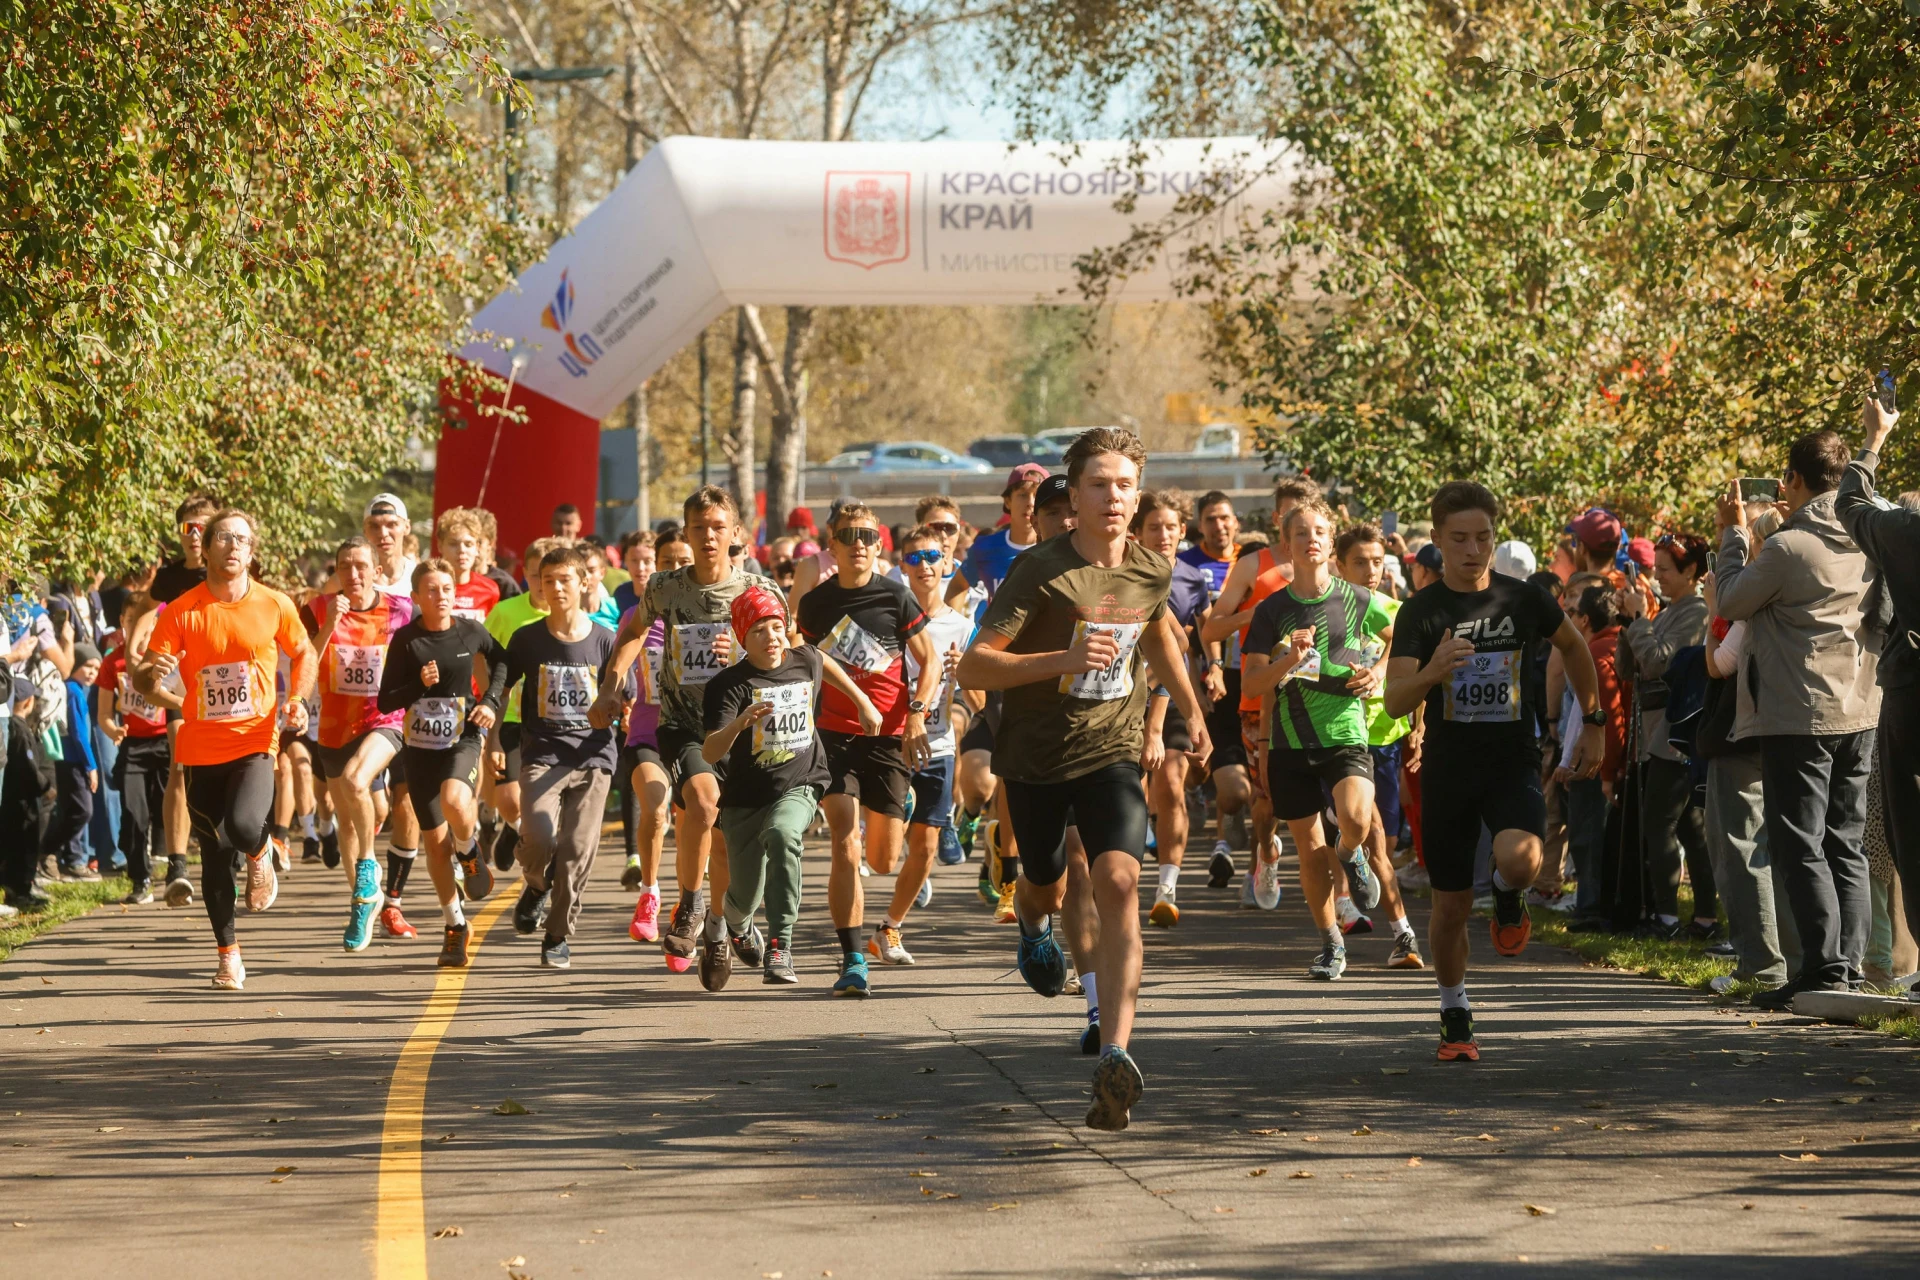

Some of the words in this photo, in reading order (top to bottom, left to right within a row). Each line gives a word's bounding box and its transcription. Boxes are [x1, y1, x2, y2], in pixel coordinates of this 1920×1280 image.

[940, 198, 1033, 230] КРАЙ
[1095, 606, 1147, 616] BEYOND
[1453, 615, 1515, 640] FILA
[1493, 638, 1517, 646] FUTURE
[344, 667, 375, 685] 383
[207, 685, 247, 706] 5186
[547, 690, 588, 707] 4682
[1455, 682, 1509, 706] 4998
[411, 718, 452, 738] 4408
[765, 711, 806, 735] 4402
